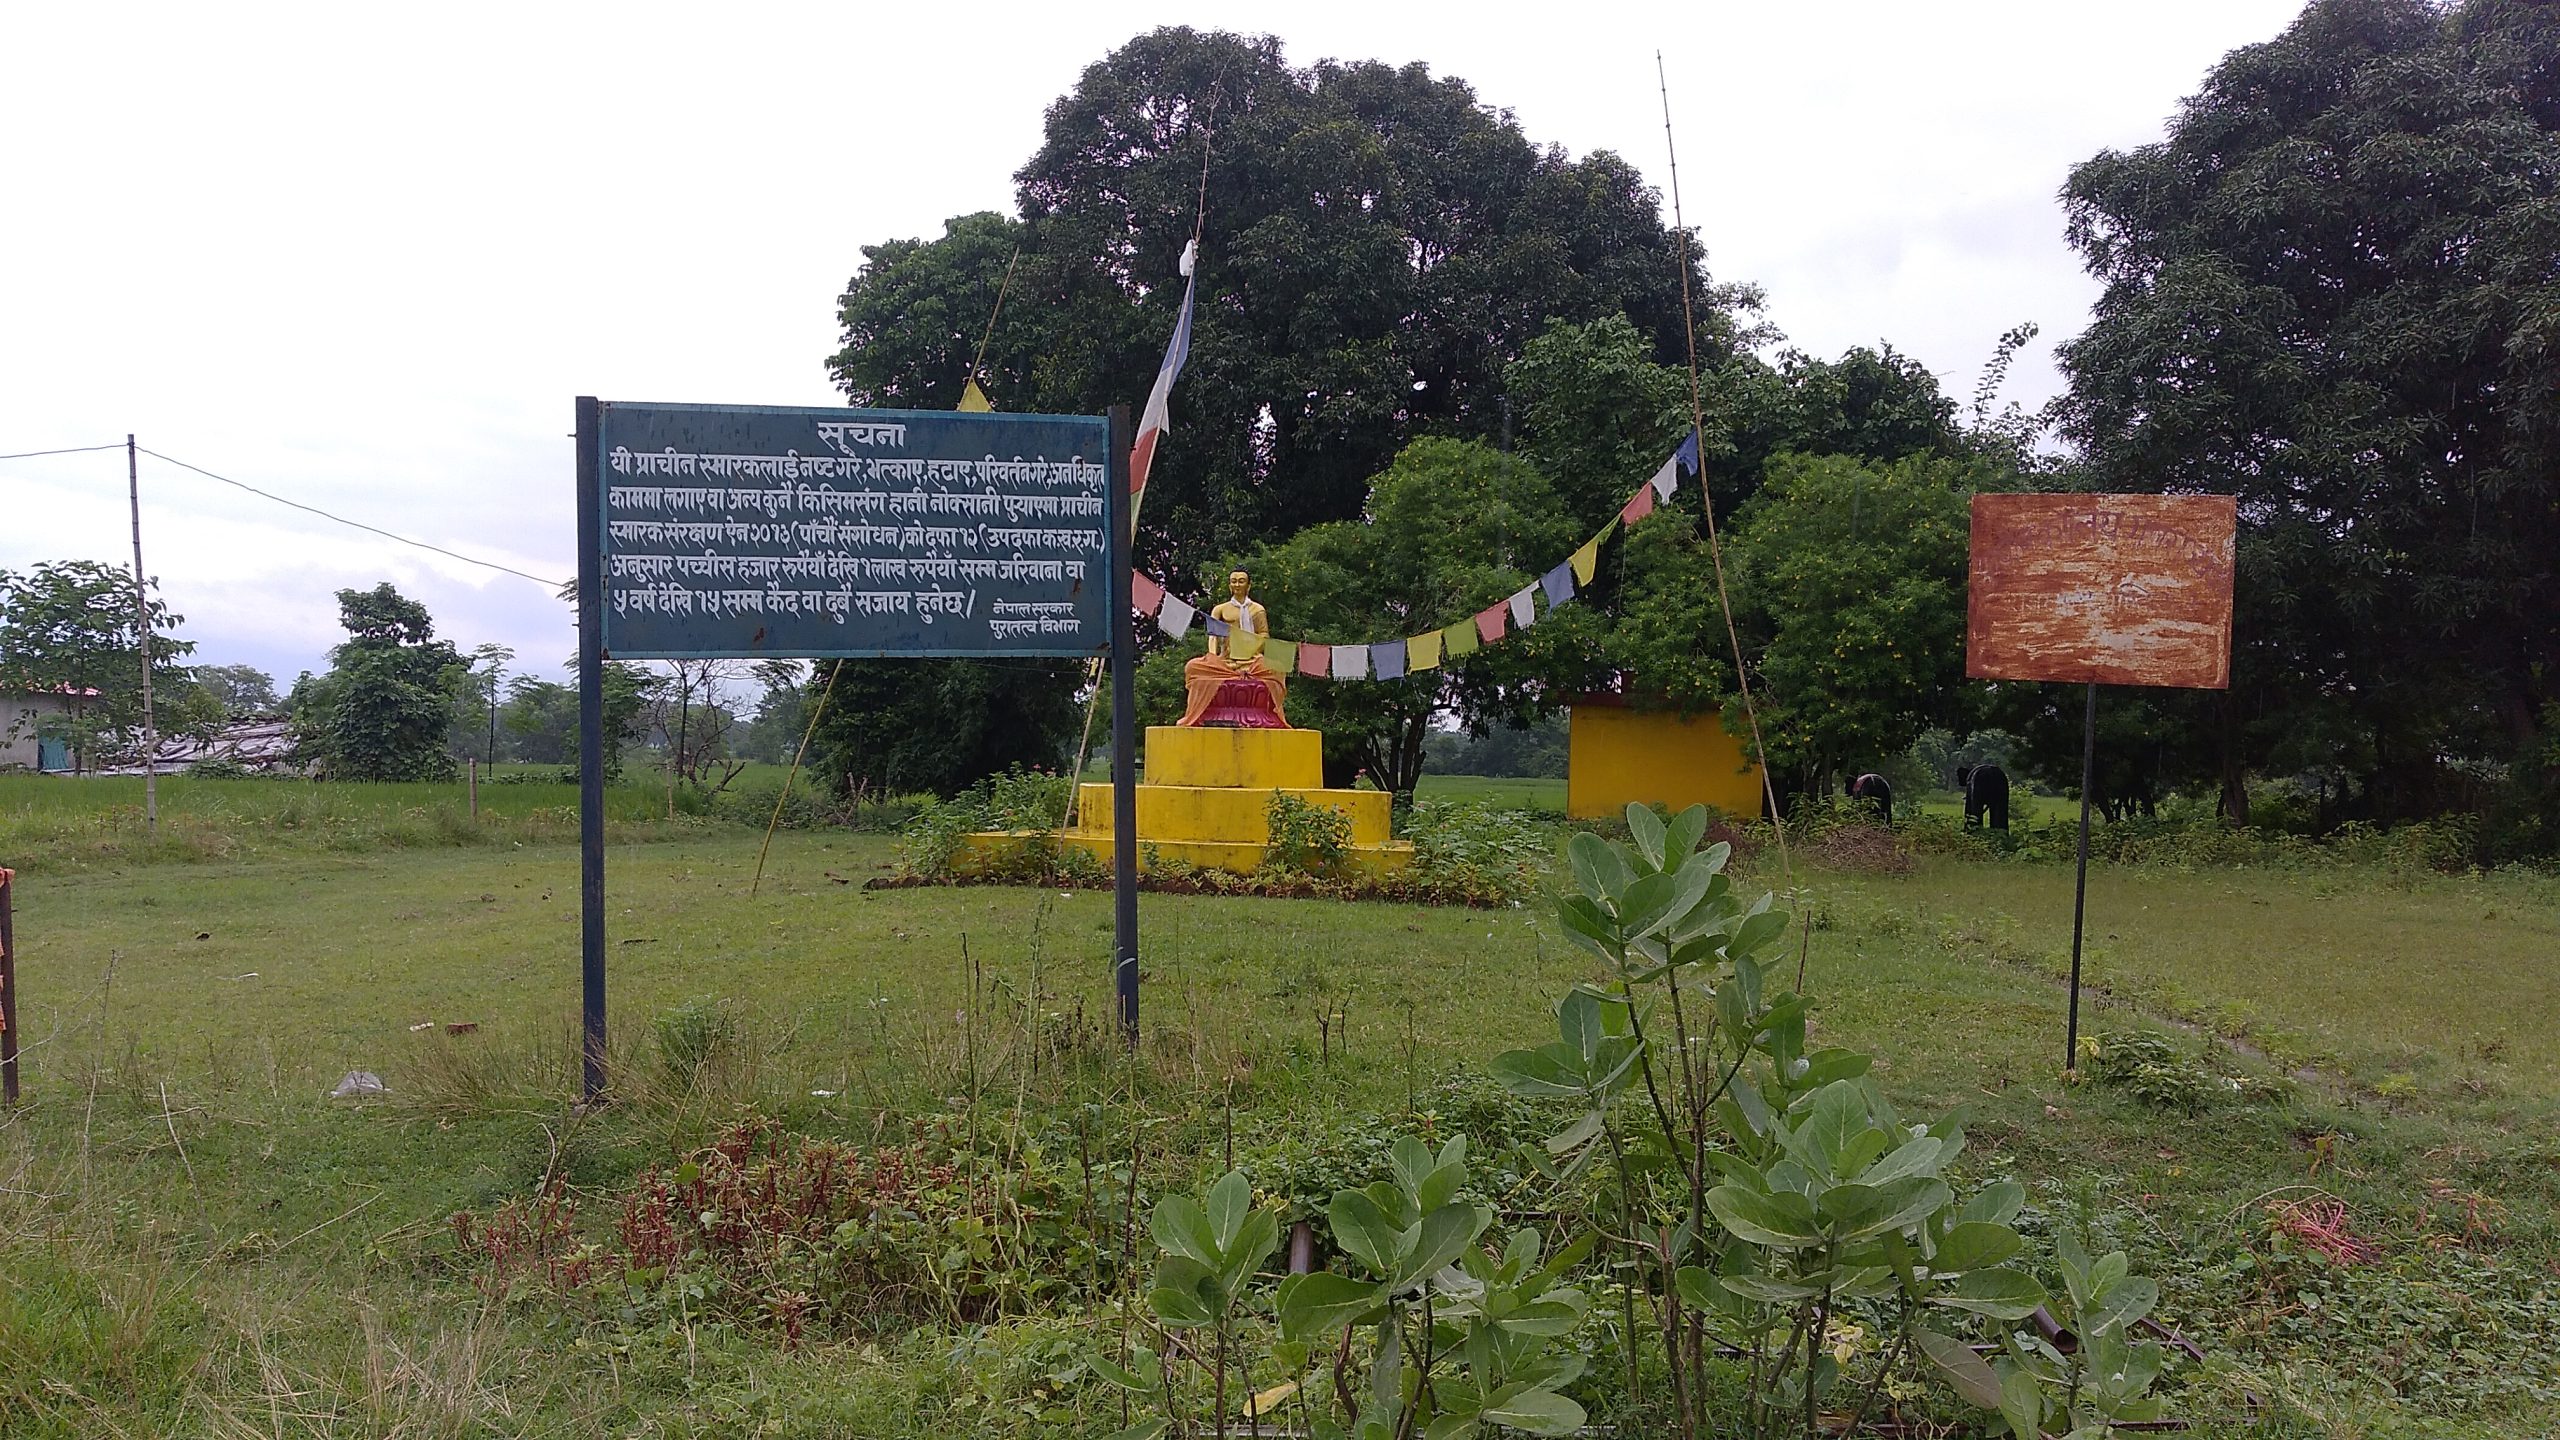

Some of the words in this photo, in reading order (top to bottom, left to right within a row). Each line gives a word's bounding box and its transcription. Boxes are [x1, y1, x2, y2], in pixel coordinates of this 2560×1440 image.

[817, 422, 906, 457] सूचना
[634, 447, 699, 477] प्राचीन
[700, 449, 800, 484] स्मारकलाई
[800, 457, 836, 481] नष्ट
[609, 486, 663, 510] काममा
[664, 488, 708, 516] लगाए
[707, 488, 726, 511] वा
[727, 488, 762, 512] अन्य
[763, 480, 795, 518] कुनै
[889, 487, 928, 521] हानी
[930, 486, 1001, 519] नोक्सानी
[1060, 491, 1104, 517] प्राचीन
[609, 521, 664, 548] स्मारक
[664, 518, 724, 549] संरक्षण
[724, 515, 750, 546] ऐन
[750, 524, 790, 551] २०१३
[926, 527, 958, 551] दफा
[960, 528, 978, 553] १२
[611, 554, 674, 582] अनुसार
[675, 549, 738, 582] पच्चीस
[738, 556, 781, 584] हजार
[828, 550, 859, 583] देखि
[959, 559, 998, 585] सम्म
[998, 552, 1063, 584] जरिवाना
[1066, 561, 1086, 580] वा
[614, 589, 626, 619] ५
[629, 582, 658, 613] वर्ष
[658, 582, 694, 618] देखि
[695, 589, 720, 620] १५
[722, 590, 764, 614] सम्म
[766, 581, 801, 619] कैद
[802, 591, 822, 613] वा
[855, 591, 912, 618] सजाय
[993, 598, 1031, 617] नेपाल
[1032, 603, 1075, 616] सरकार
[1039, 616, 1081, 634] विभाग
